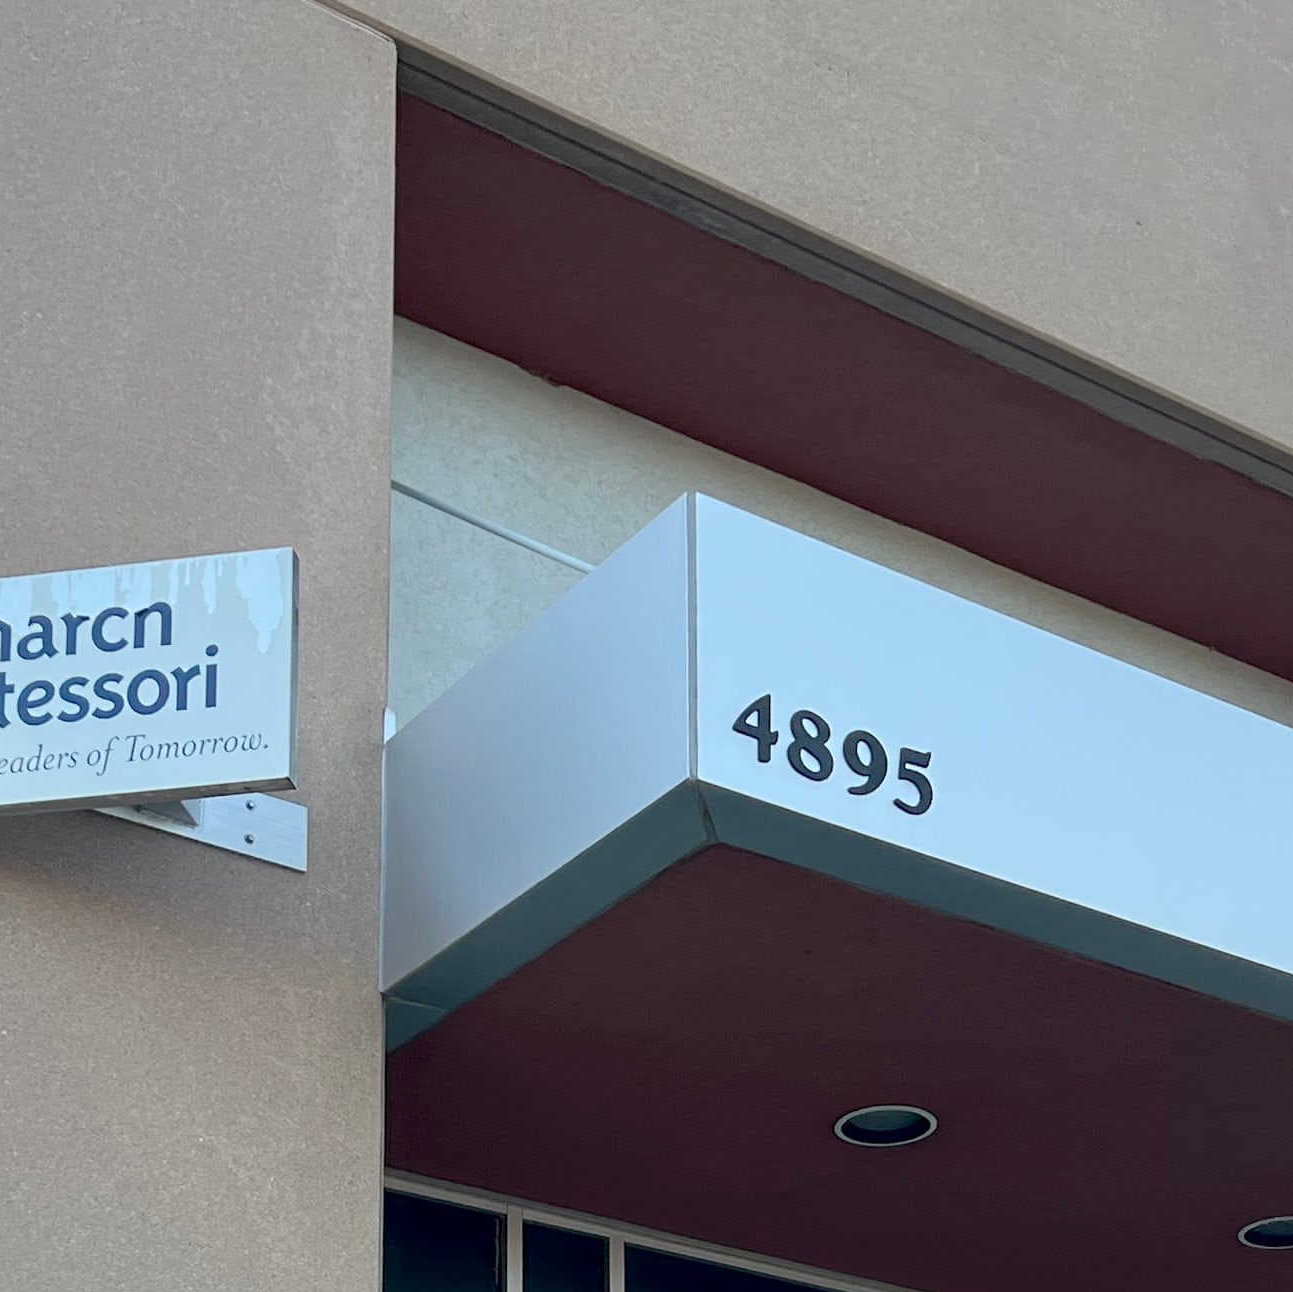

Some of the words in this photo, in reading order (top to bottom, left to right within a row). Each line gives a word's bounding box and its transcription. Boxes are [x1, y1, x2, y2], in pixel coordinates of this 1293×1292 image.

[86, 736, 120, 777] of
[125, 733, 269, 763] Tomorrow.
[732, 693, 934, 816] 4895
